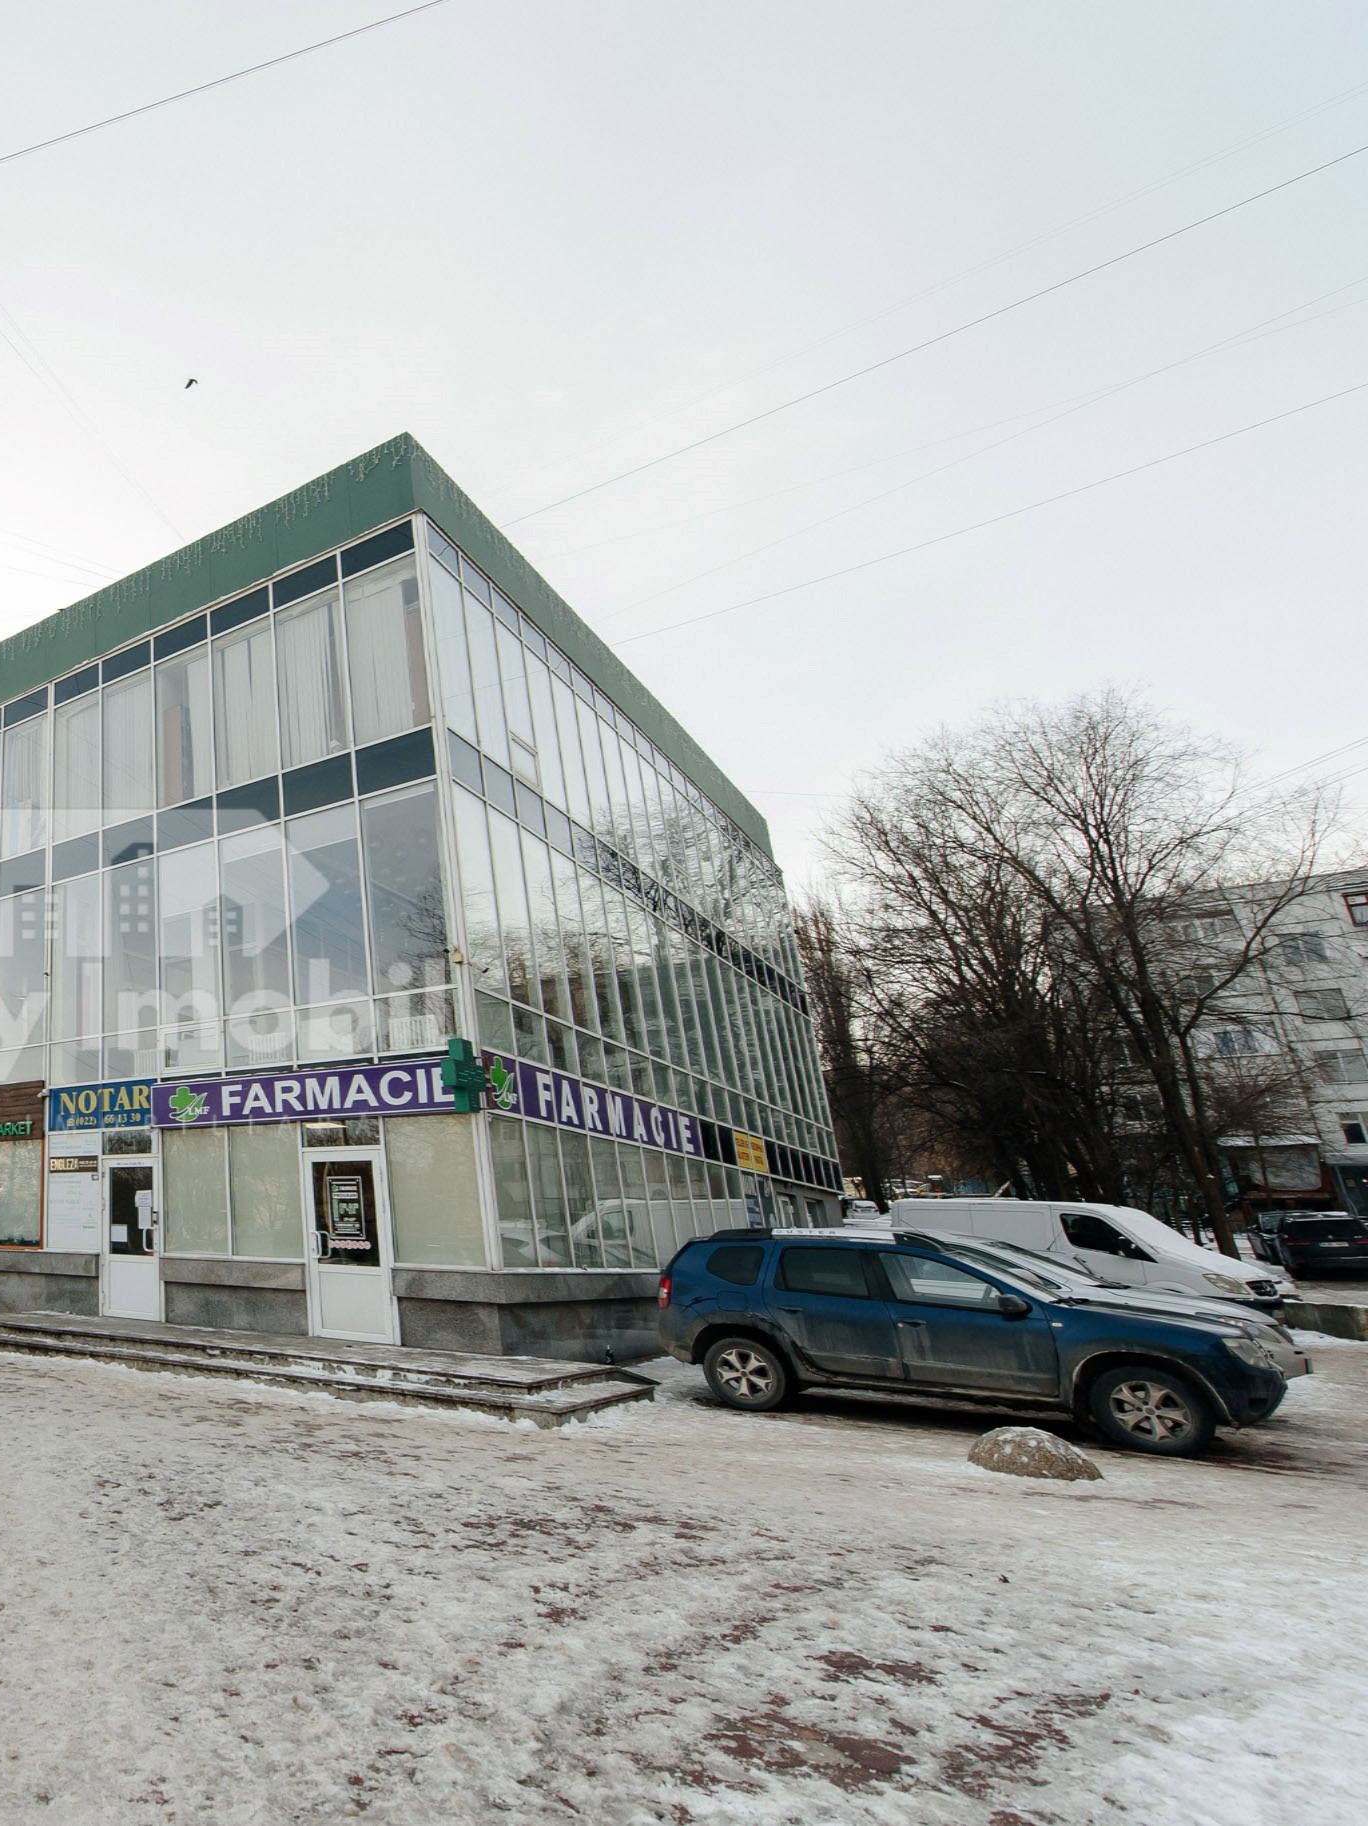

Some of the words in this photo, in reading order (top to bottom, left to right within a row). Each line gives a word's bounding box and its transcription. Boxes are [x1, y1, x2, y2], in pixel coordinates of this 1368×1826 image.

[59, 1085, 151, 1116] NOTAR
[188, 1106, 211, 1116] LMF
[535, 1071, 695, 1154] FARMACIE
